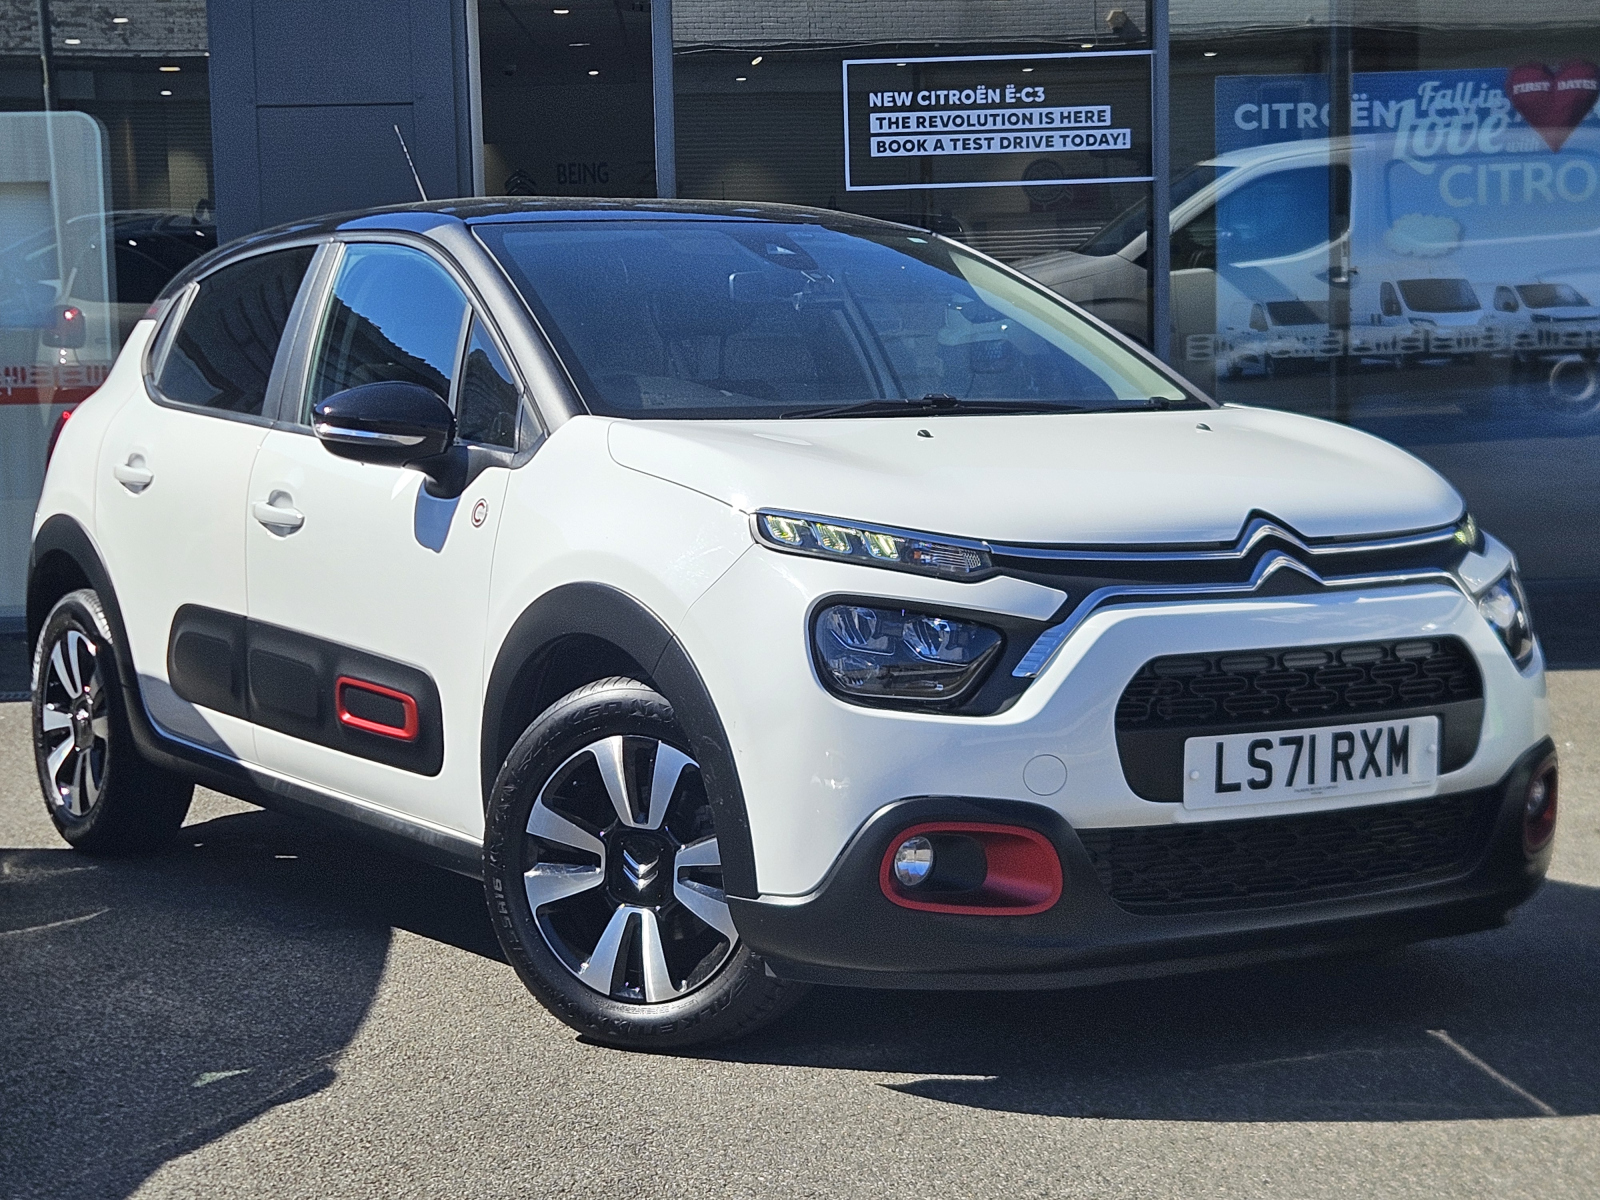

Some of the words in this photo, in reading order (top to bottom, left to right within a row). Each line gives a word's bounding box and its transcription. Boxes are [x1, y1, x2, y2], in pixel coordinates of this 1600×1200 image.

[870, 92, 912, 107] NEW
[917, 85, 1000, 105] CITROËN
[1006, 85, 1045, 103] Ë-C3
[1417, 81, 1474, 110] Fall
[1476, 83, 1504, 109] in
[1513, 81, 1551, 94] FIRST
[876, 116, 911, 130] THE
[917, 111, 1033, 129] REVOLUTION
[1039, 111, 1055, 125] IS
[1060, 109, 1107, 124] HERE
[876, 138, 928, 154] BOOK
[933, 137, 945, 151] A
[949, 136, 995, 151] TEST
[1000, 134, 1054, 150] DRIVE
[1059, 132, 1127, 147] TODAY!
[1392, 97, 1510, 175] Love
[556, 163, 609, 185] BEING
[1215, 735, 1316, 793] LS71
[1330, 725, 1410, 783] RXM
